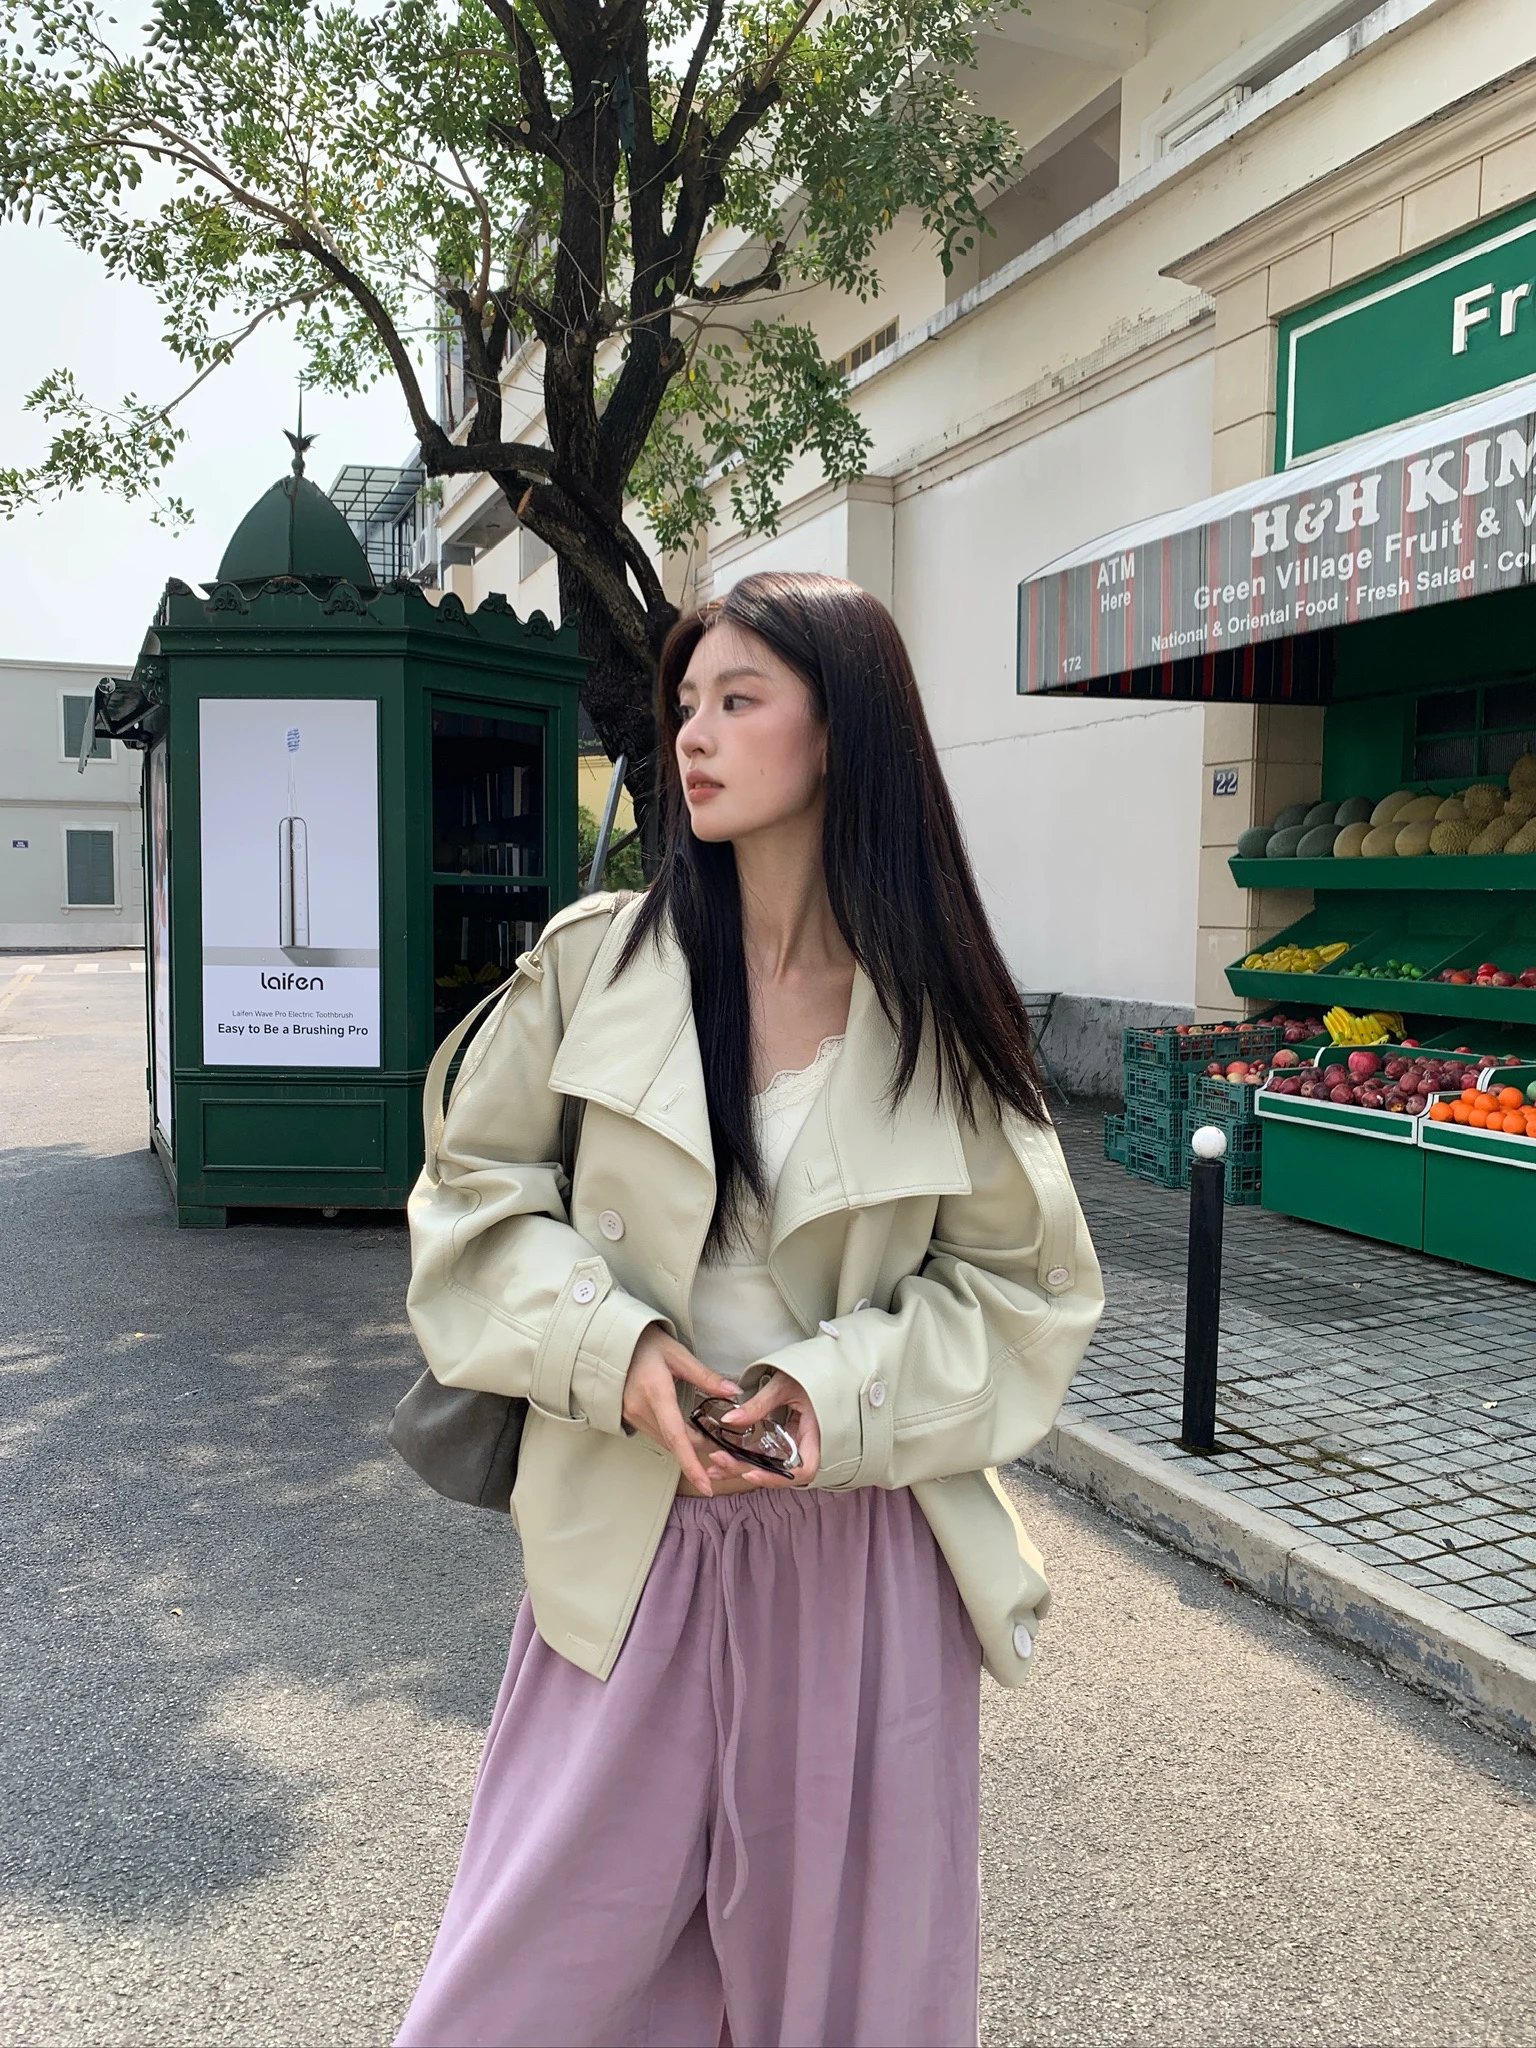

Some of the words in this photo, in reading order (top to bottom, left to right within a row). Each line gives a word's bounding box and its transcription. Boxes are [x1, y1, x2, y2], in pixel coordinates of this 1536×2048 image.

[1452, 282, 1532, 355] Fr
[1251, 474, 1382, 557] H&H
[1096, 552, 1135, 590] ATM
[1193, 575, 1266, 611] Green
[1275, 547, 1373, 590] Village
[1385, 517, 1463, 563] Fruit
[1476, 507, 1501, 539] &
[1100, 590, 1131, 614] Here
[1151, 624, 1207, 652] National
[1211, 620, 1223, 637] &
[1228, 604, 1290, 634] Oriental
[1295, 592, 1339, 620] Food
[1356, 577, 1410, 605] Fresh
[1416, 559, 1475, 591] Salad
[1061, 656, 1082, 674] 172
[1216, 772, 1237, 794] 22
[261, 972, 324, 991] laifen
[232, 1010, 254, 1018] Laifen
[255, 1010, 274, 1018] Wave
[315, 1011, 354, 1019] Toothbrush
[218, 1023, 245, 1036] Easy
[249, 1025, 260, 1034] to
[264, 1024, 279, 1034] Be
[282, 1027, 290, 1035] a
[293, 1024, 345, 1038] Brushing
[348, 1025, 369, 1036] Pro
